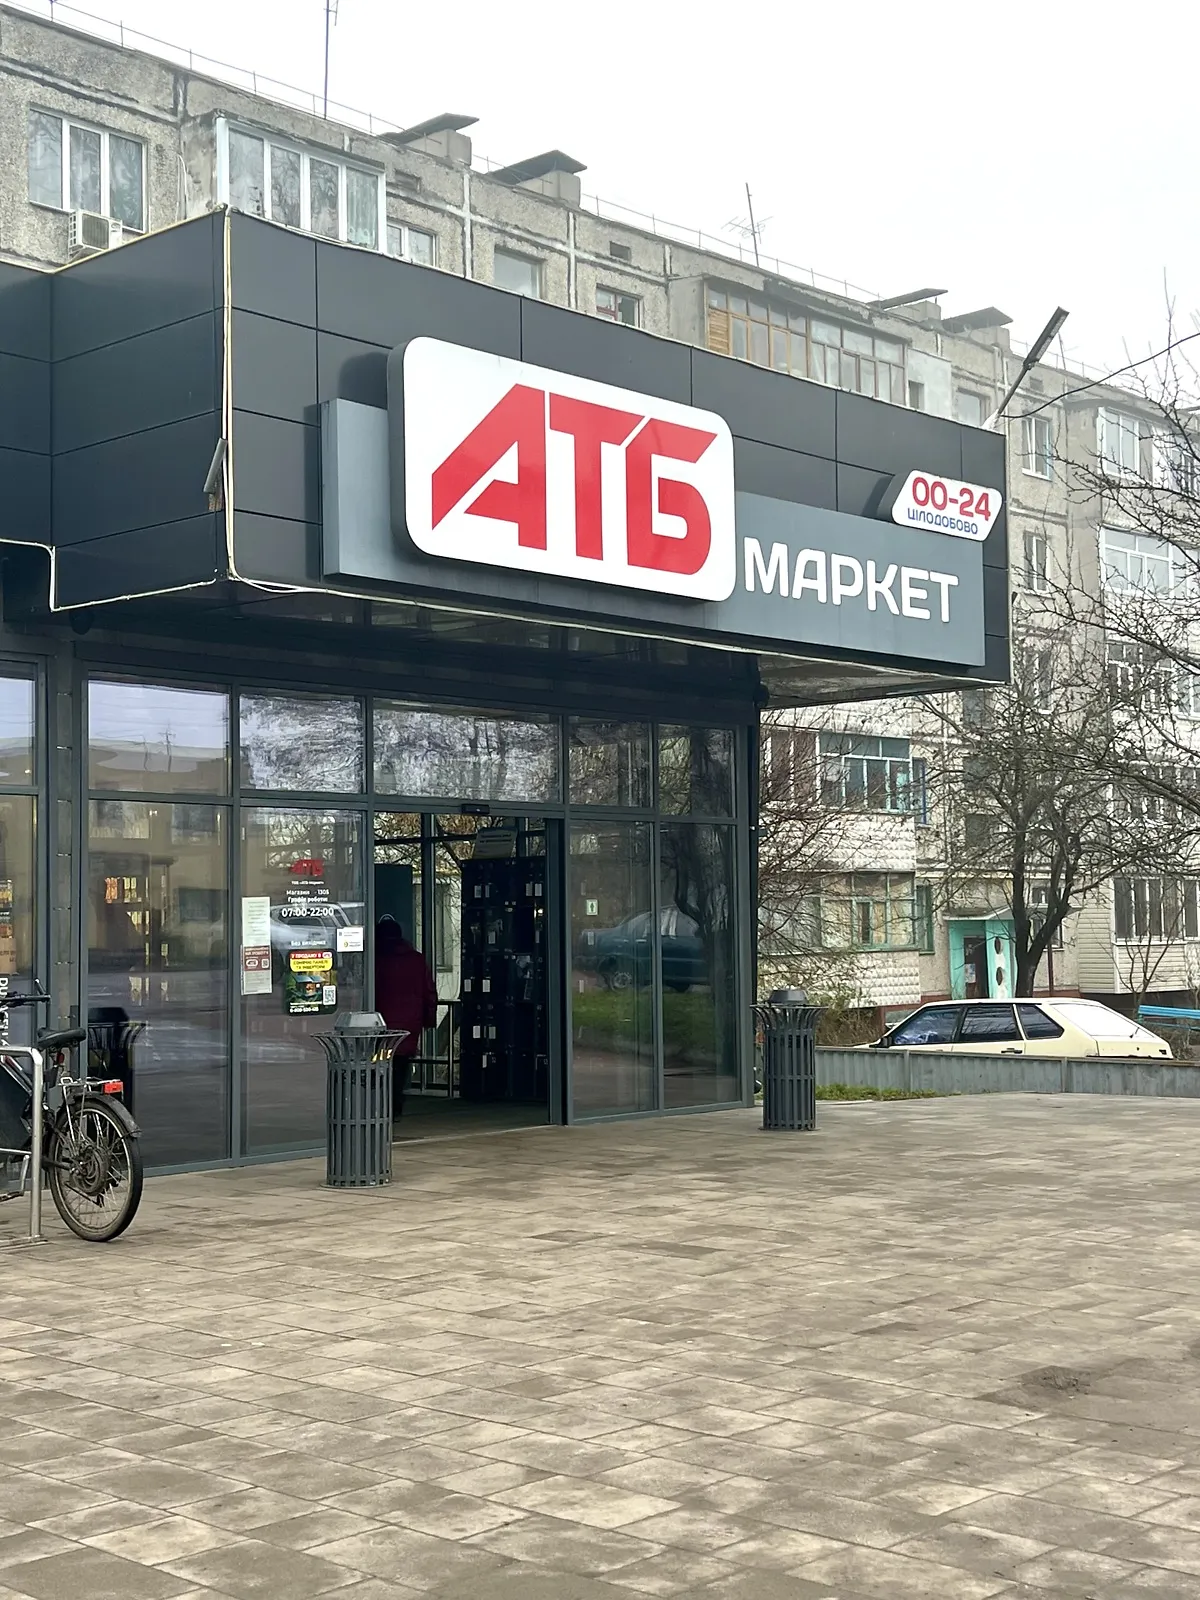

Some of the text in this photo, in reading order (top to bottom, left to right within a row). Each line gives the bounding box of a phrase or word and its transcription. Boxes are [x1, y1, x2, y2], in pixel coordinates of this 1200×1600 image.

[431, 383, 718, 575] АТБ
[912, 476, 991, 521] 00-24
[907, 507, 978, 535] ЦІЛОДОБОВО
[743, 536, 960, 624] МАРКЕТ
[281, 907, 335, 917] 07:00-22:00
